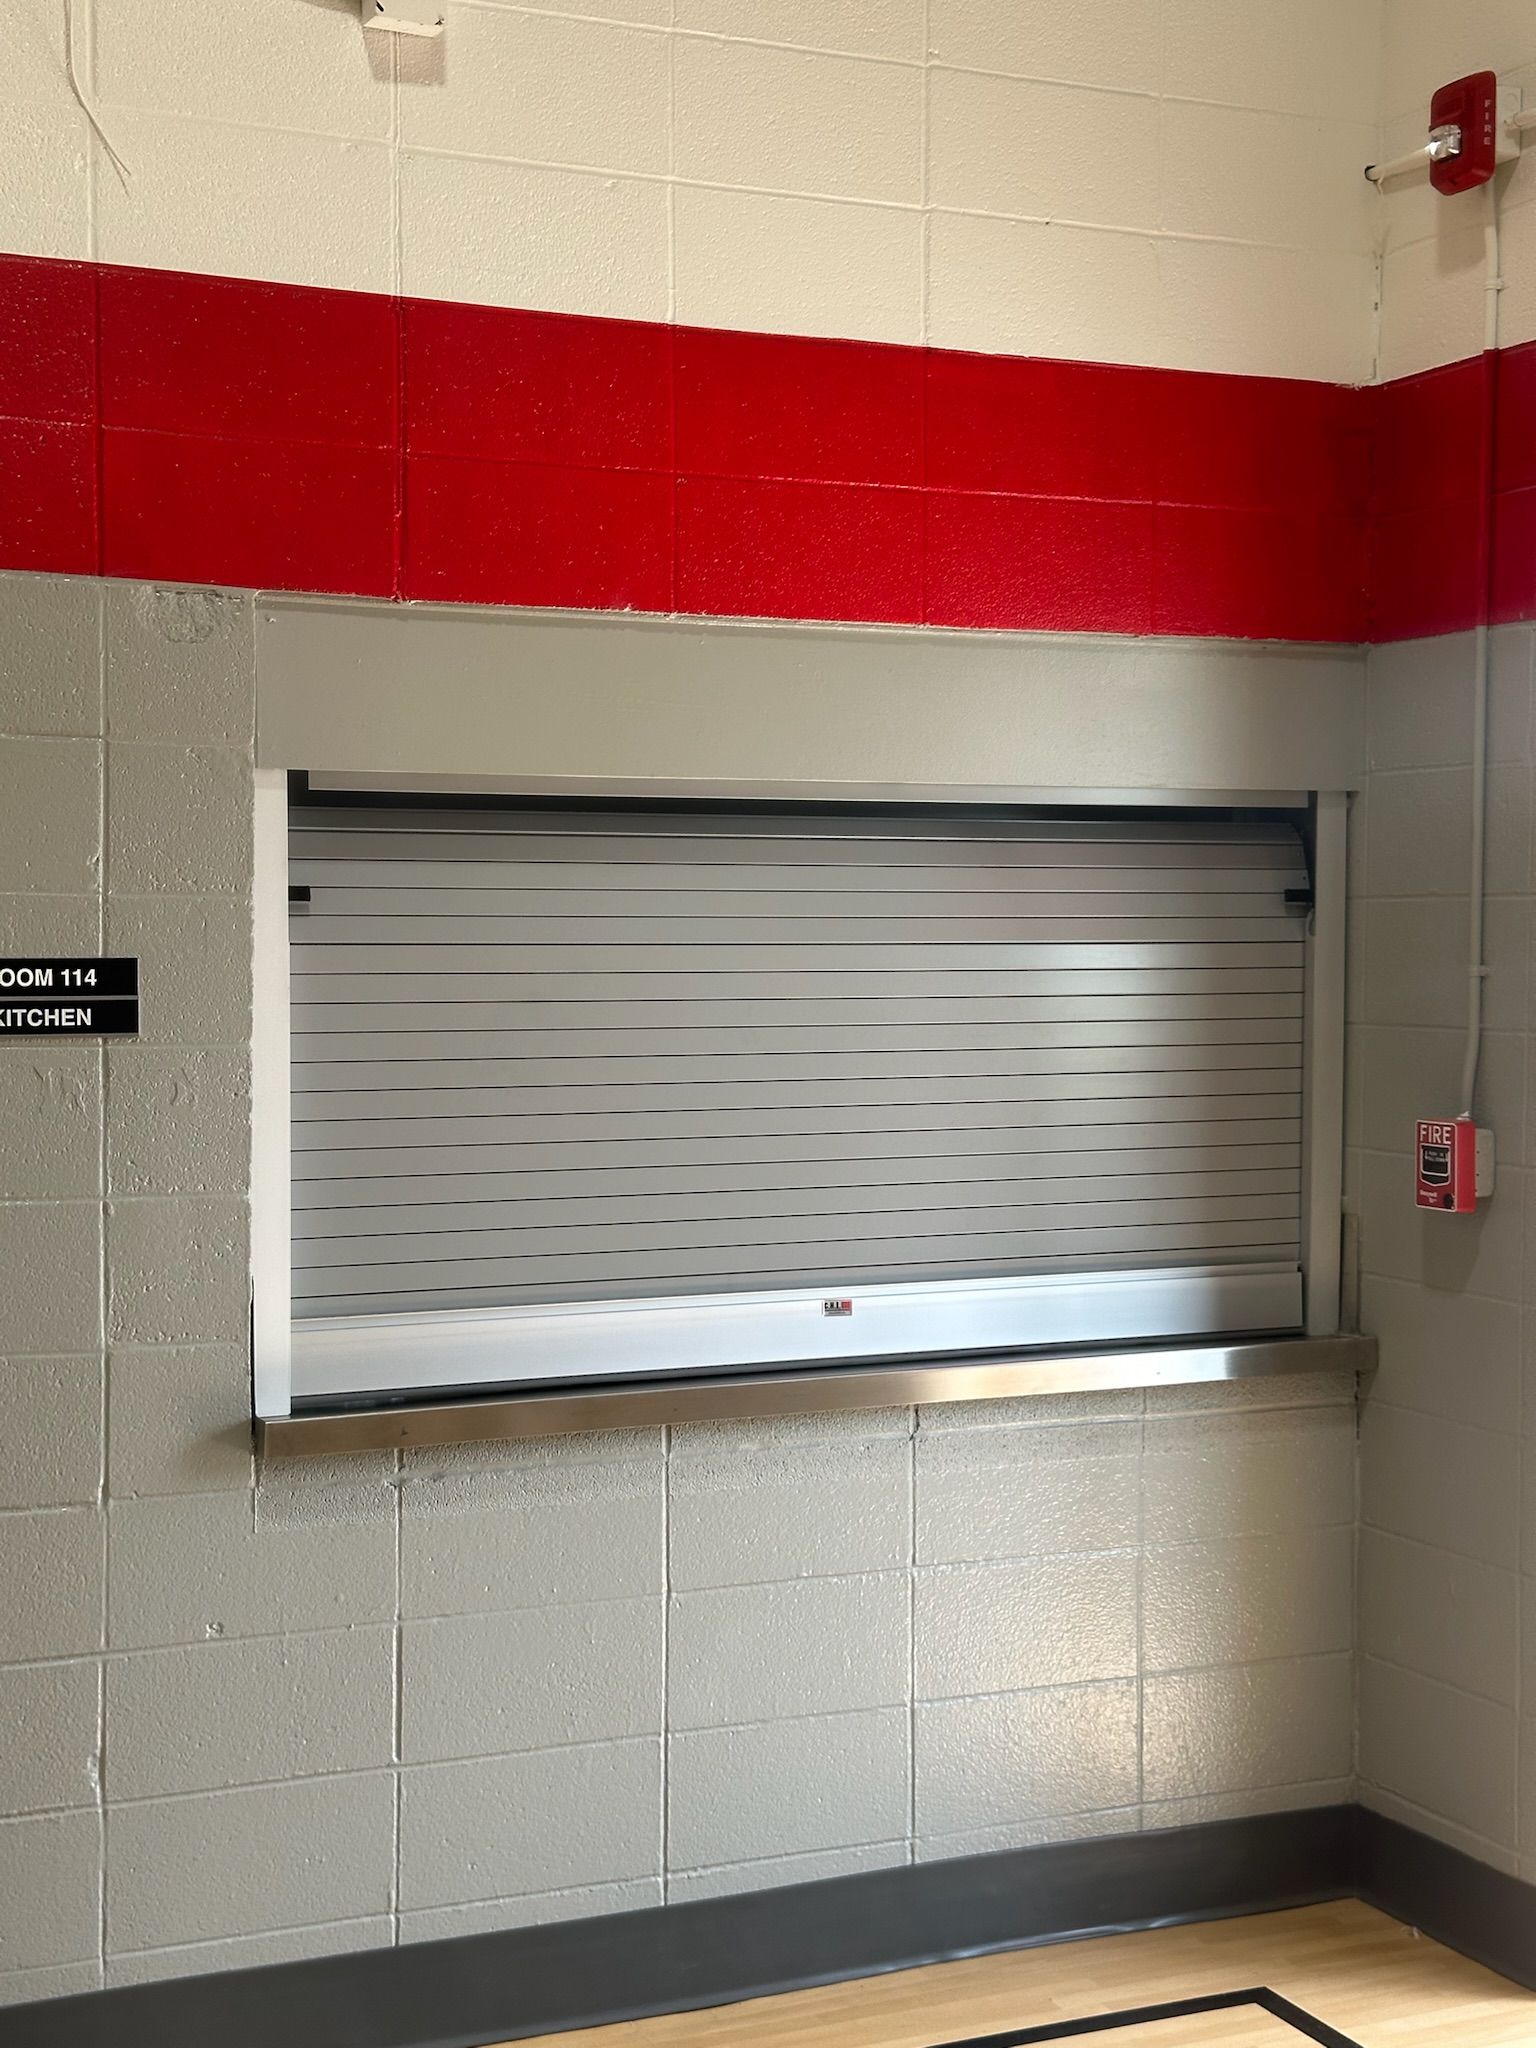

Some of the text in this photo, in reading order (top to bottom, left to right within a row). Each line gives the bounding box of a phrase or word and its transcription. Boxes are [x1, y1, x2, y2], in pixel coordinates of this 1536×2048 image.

[1483, 99, 1492, 145] FIRE
[61, 968, 97, 987] 114
[1420, 1124, 1452, 1145] FIRE
